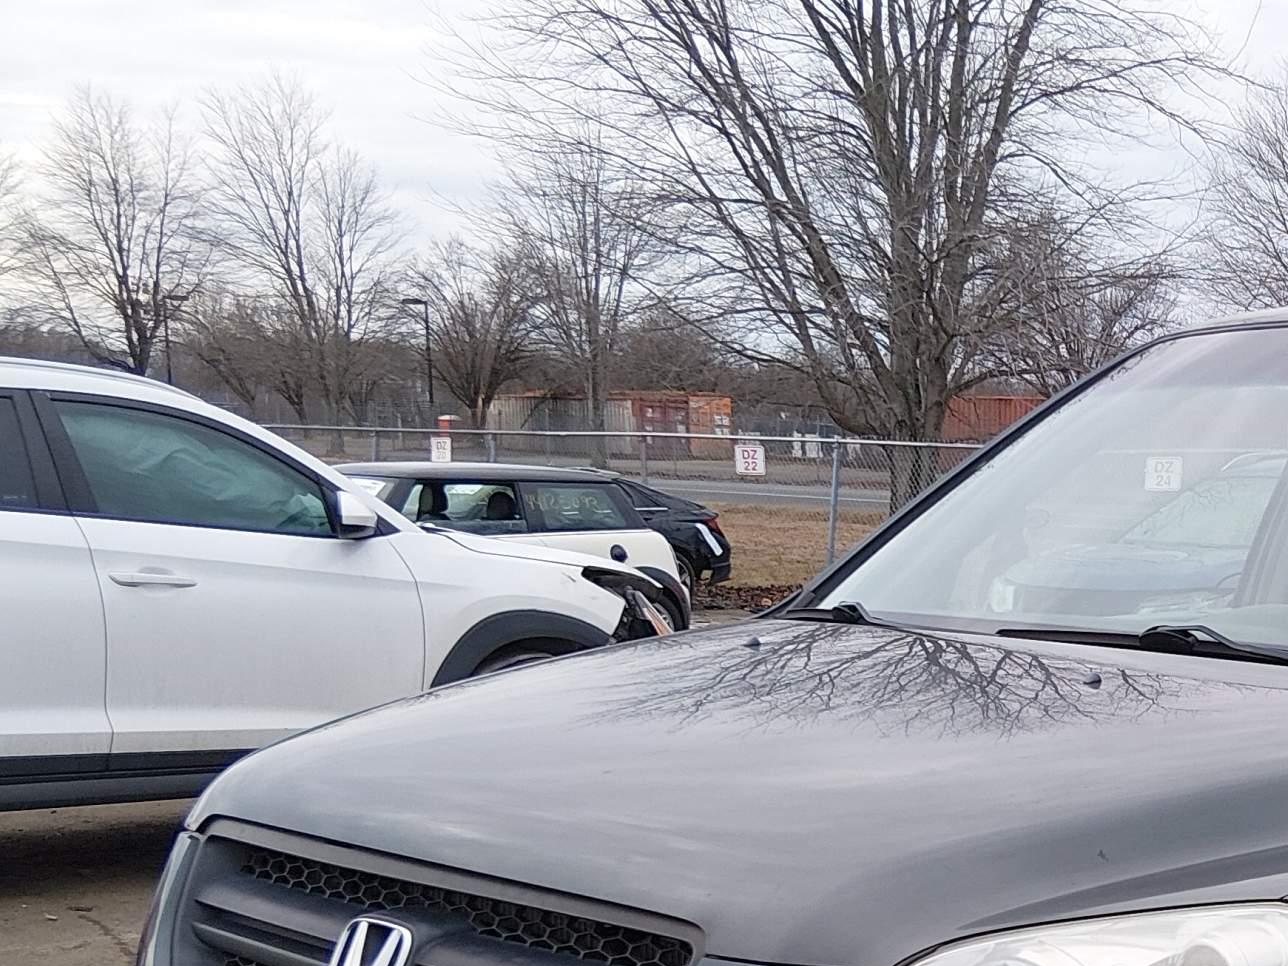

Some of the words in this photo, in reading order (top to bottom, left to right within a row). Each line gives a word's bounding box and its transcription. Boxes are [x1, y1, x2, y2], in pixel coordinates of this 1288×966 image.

[741, 449, 759, 460] DZ
[743, 461, 758, 471] 22
[1154, 460, 1175, 473] DZ
[1154, 474, 1171, 487] 24
